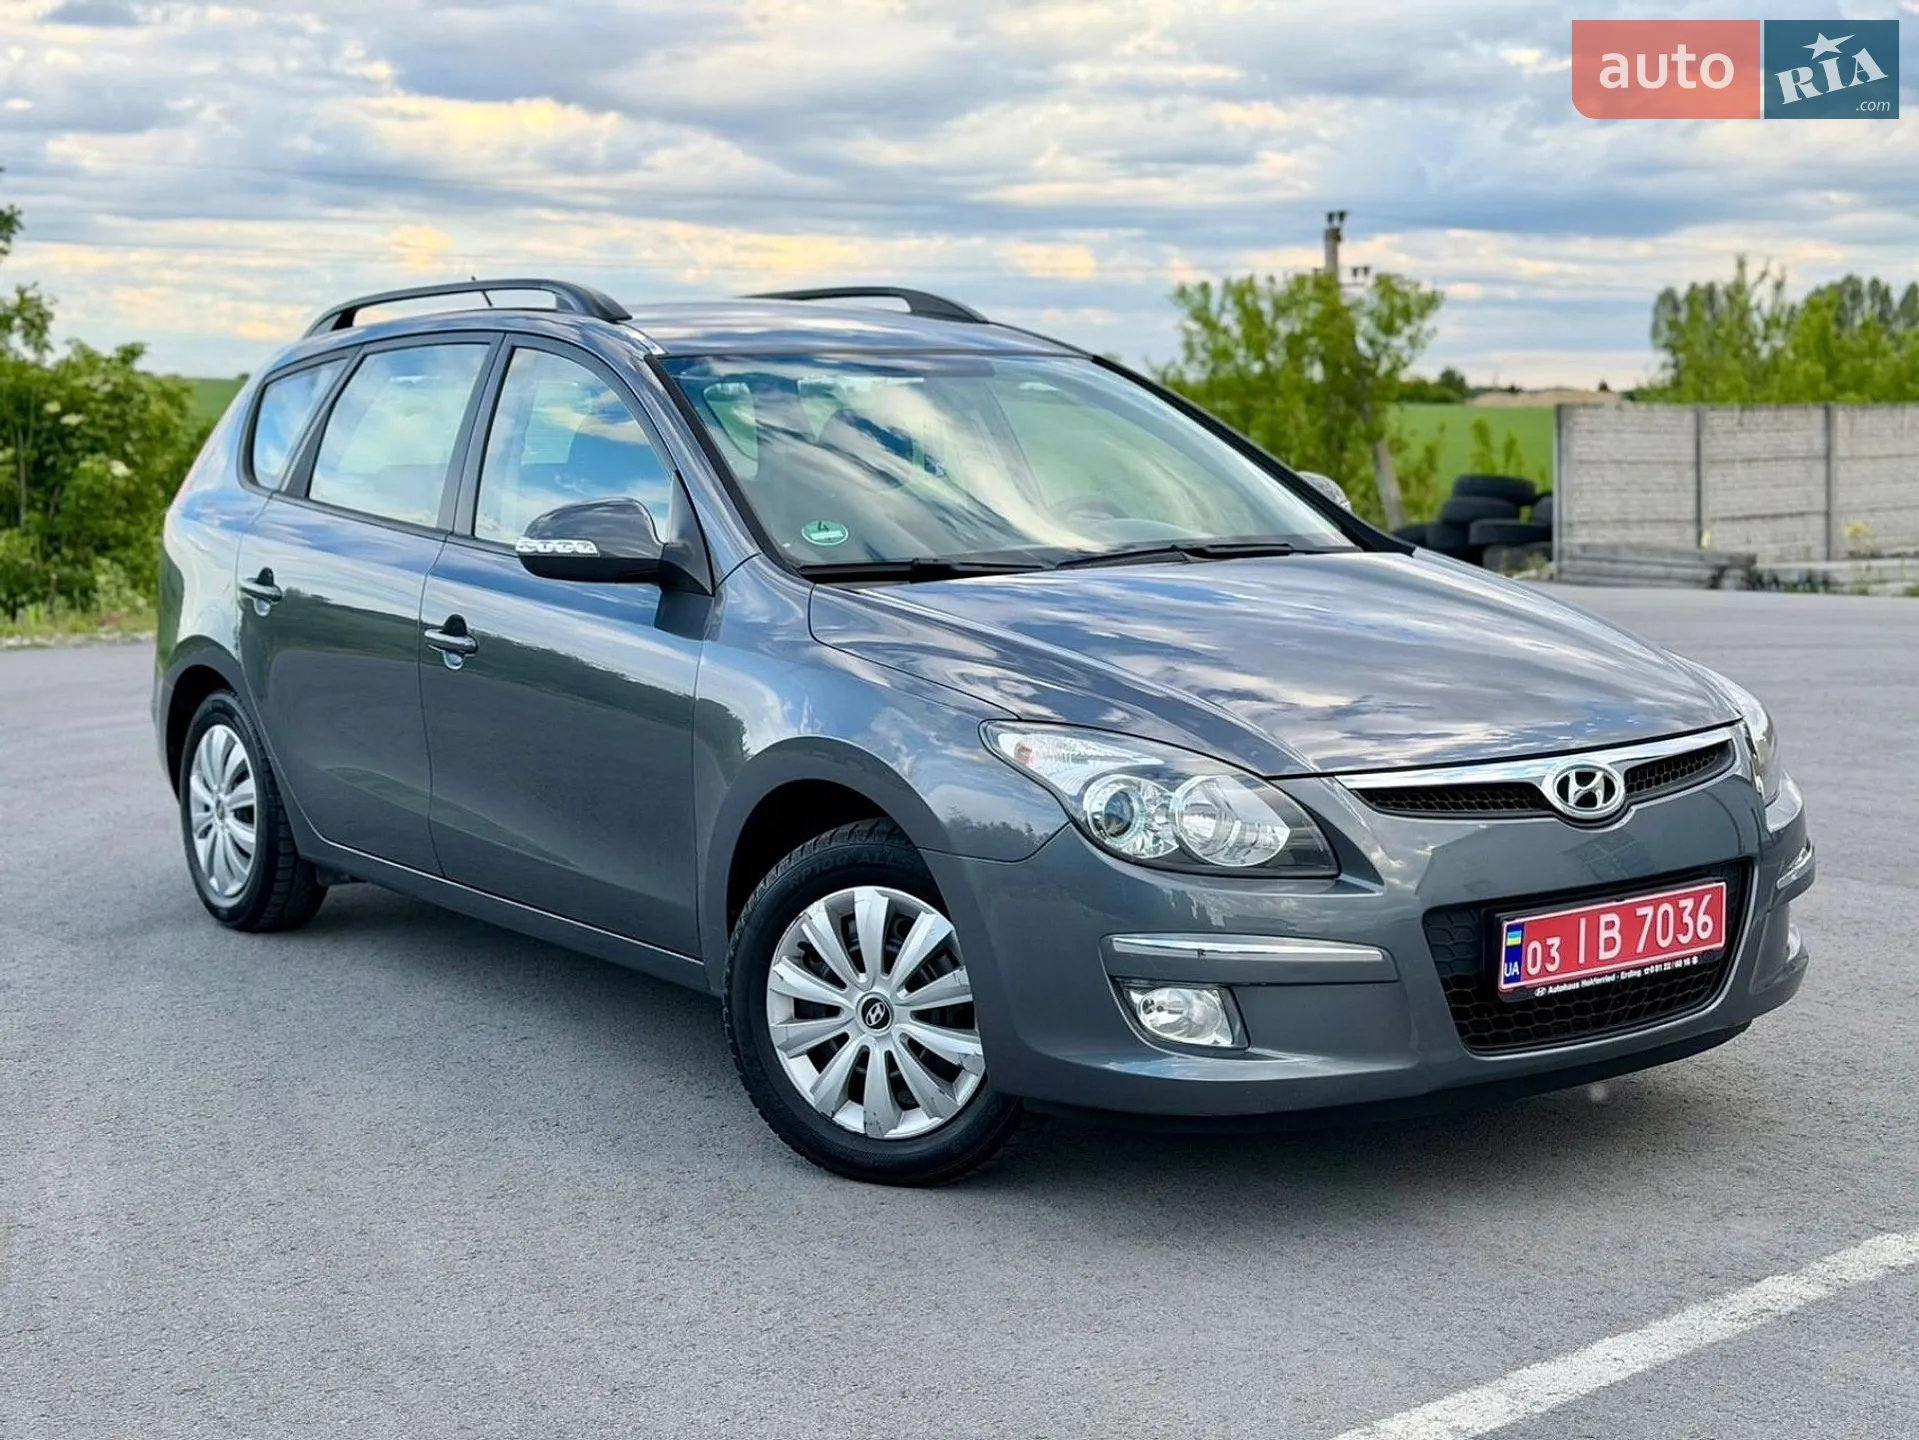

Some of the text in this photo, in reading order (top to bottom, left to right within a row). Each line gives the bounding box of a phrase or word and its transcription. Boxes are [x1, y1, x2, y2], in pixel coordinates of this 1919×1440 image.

[1526, 894, 1713, 976] 03 IB 7036
[1504, 961, 1519, 977] UA
[1547, 982, 1580, 994] Autohaus
